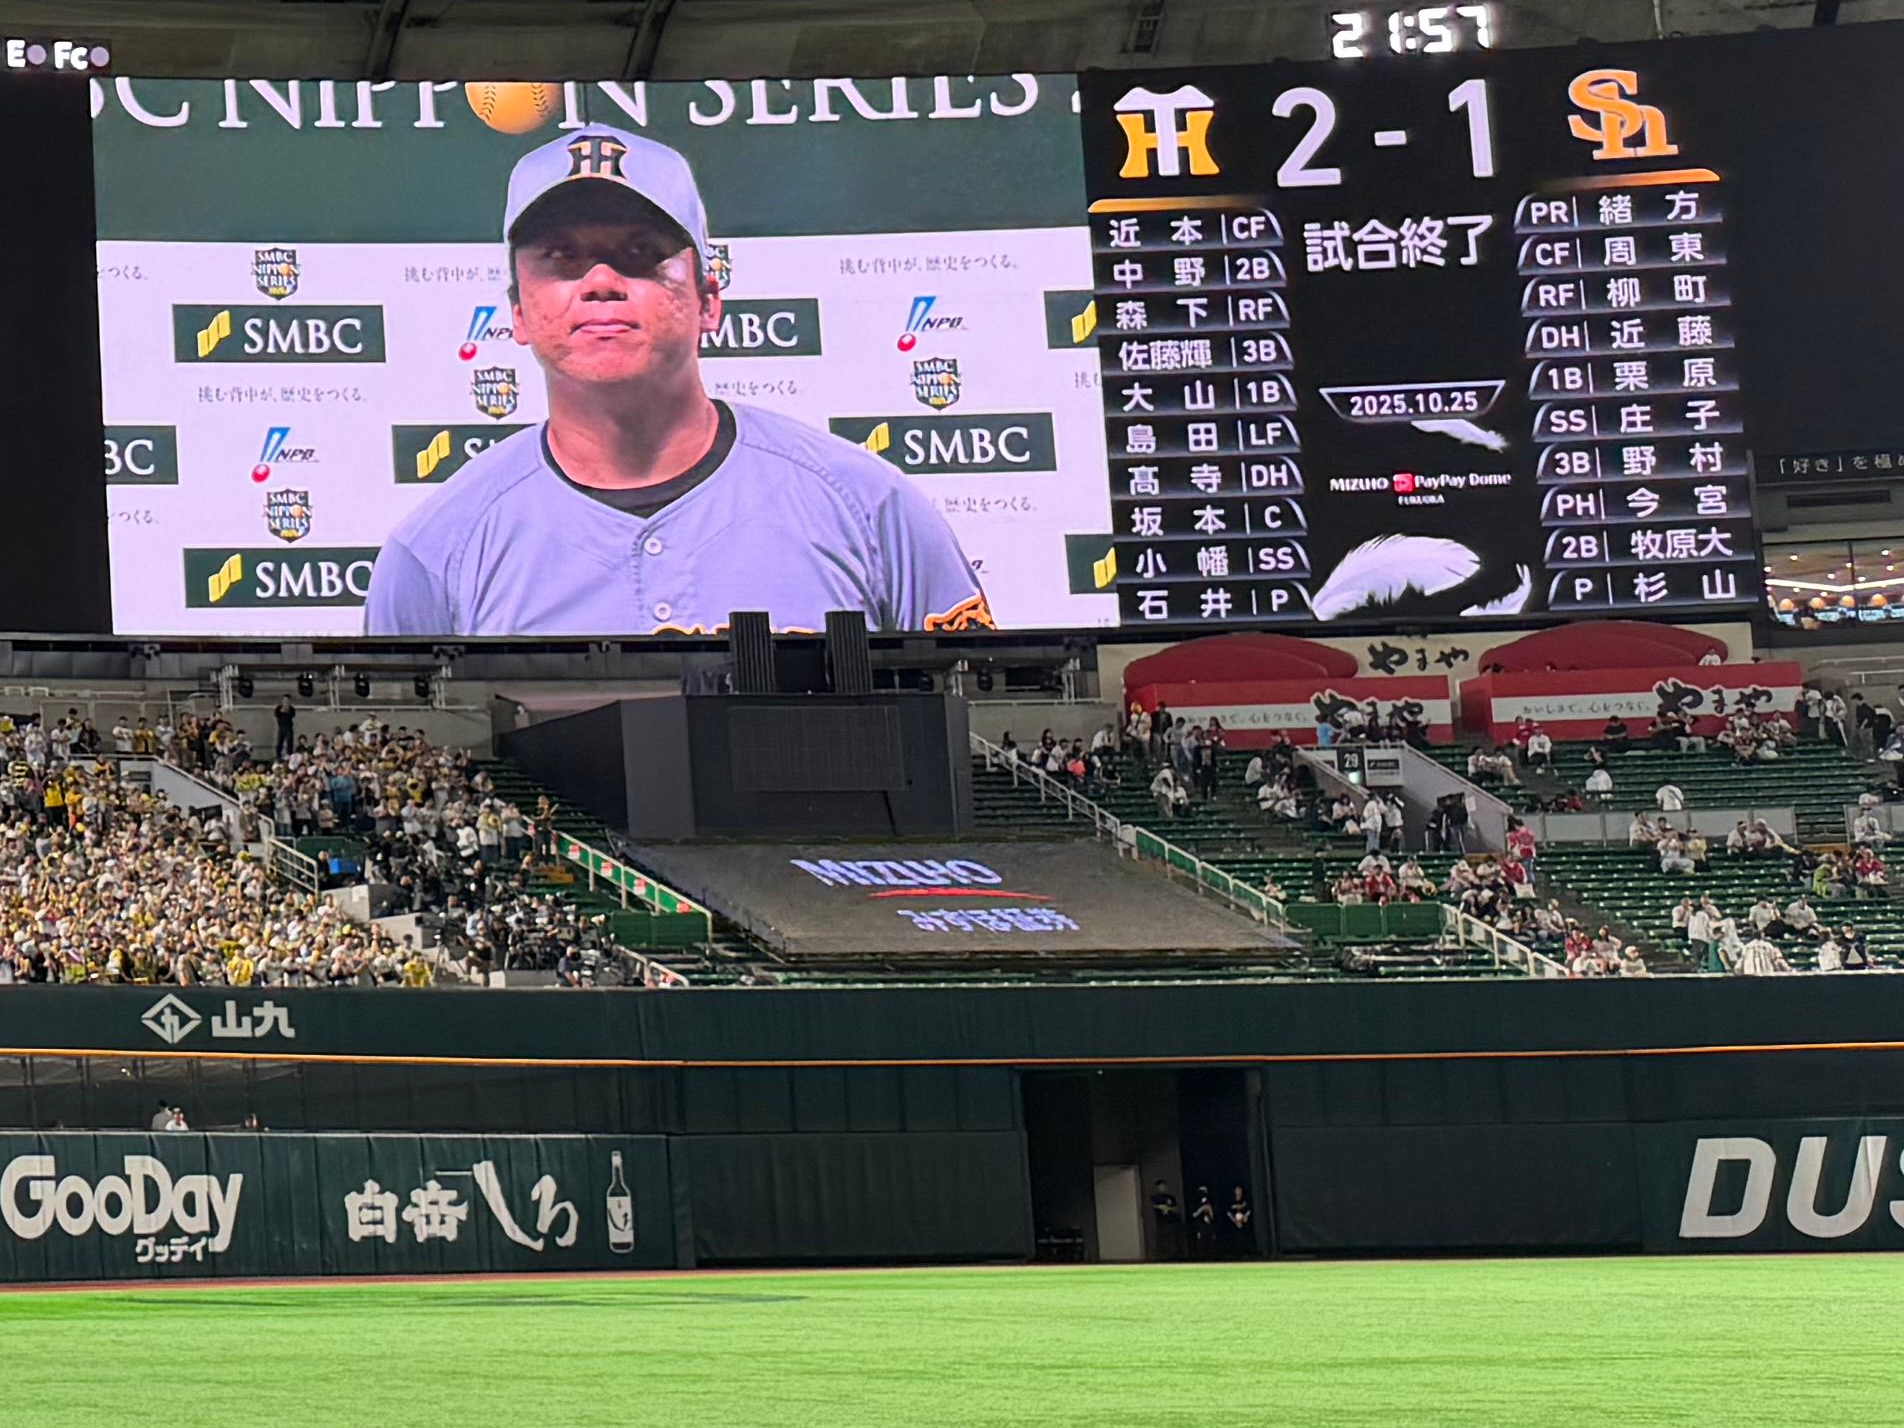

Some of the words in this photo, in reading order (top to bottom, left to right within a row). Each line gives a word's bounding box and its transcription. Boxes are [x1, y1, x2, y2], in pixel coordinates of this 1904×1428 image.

[1331, 4, 1492, 59] 21:57
[6, 38, 27, 69] E
[1271, 86, 1342, 188] 2
[1448, 78, 1495, 178] 1
[1530, 200, 1569, 225] PR
[1232, 216, 1266, 240] CF
[1303, 214, 1494, 273] 試合終了
[1535, 241, 1571, 266] CF
[1235, 258, 1270, 281] 2B
[1538, 283, 1575, 308] RF
[1238, 298, 1274, 321] RF
[243, 317, 364, 355] SMBC
[1541, 324, 1580, 349] DH
[1242, 340, 1277, 363] 3B
[1548, 367, 1584, 391] 1B
[1247, 381, 1281, 404] 1B
[1349, 390, 1479, 417] 2025.10.25
[1549, 409, 1588, 433] SS
[904, 426, 1030, 467] SMBC
[1250, 423, 1283, 446] LF
[1554, 451, 1591, 475] 3B
[1251, 464, 1288, 487] DH
[1414, 474, 1466, 490] PayPay
[1556, 493, 1595, 517] PH
[1264, 506, 1283, 529] C
[1258, 547, 1295, 571] SS
[1561, 535, 1599, 560] 2B
[1271, 589, 1289, 612] P
[1574, 577, 1594, 601] P
[210, 998, 296, 1039] 山九
[135, 1236, 211, 1264] グッデイ
